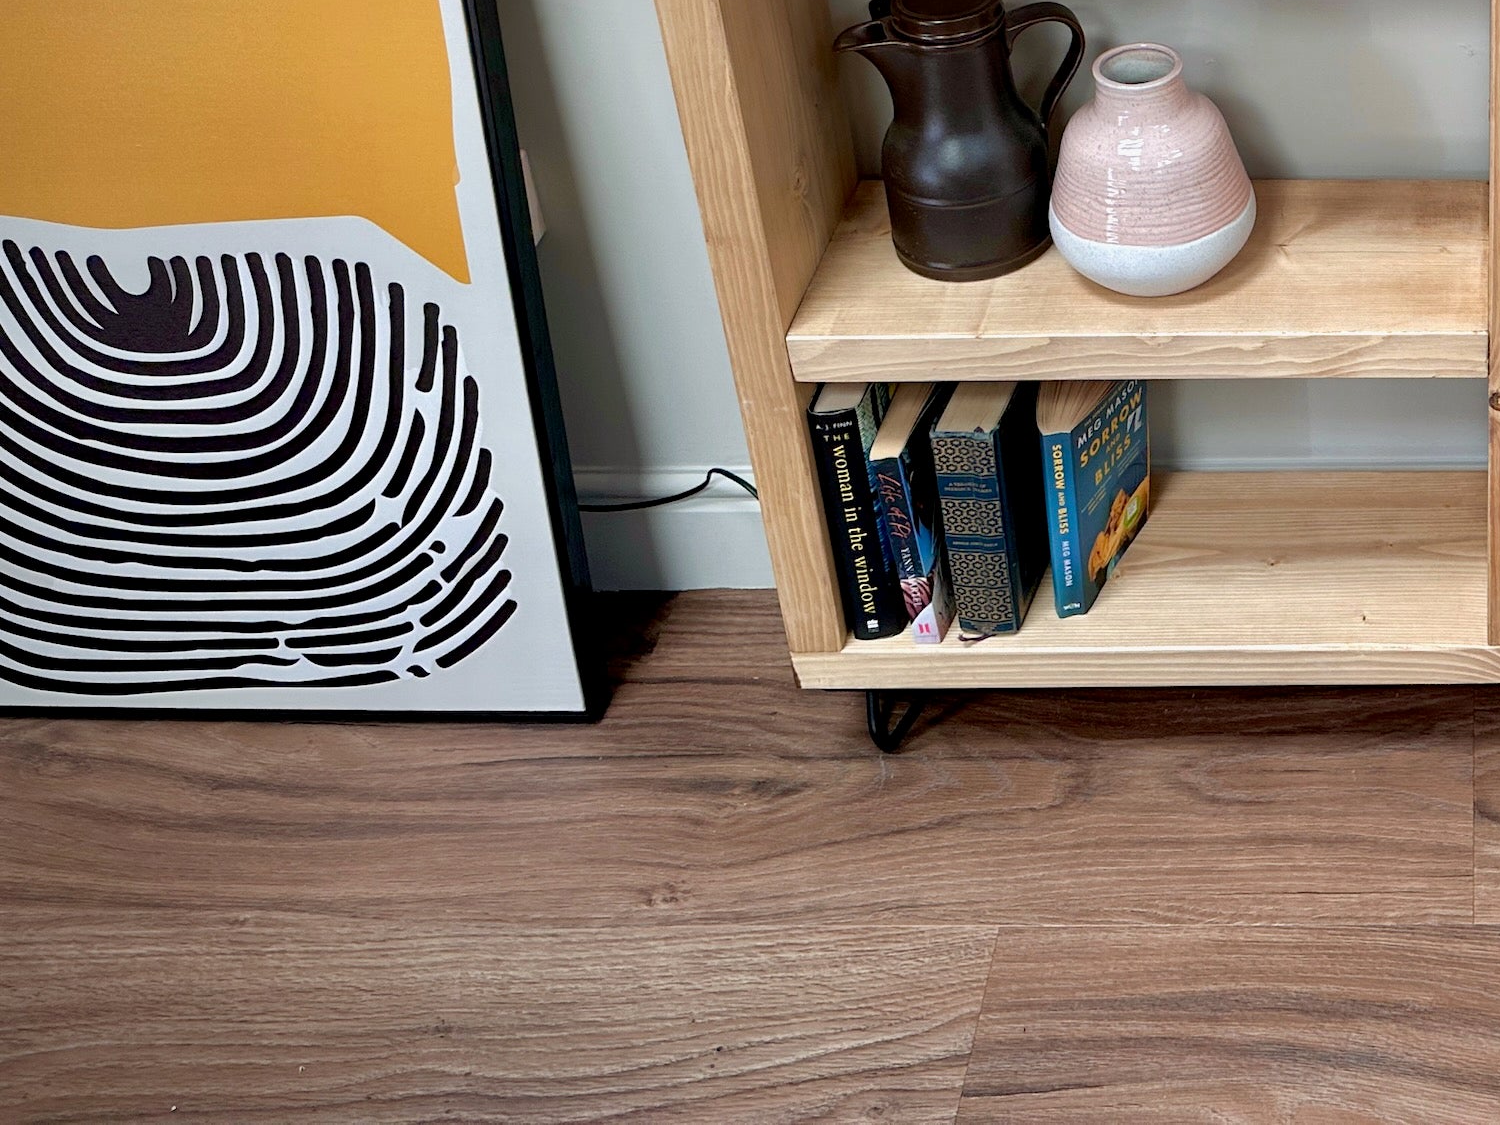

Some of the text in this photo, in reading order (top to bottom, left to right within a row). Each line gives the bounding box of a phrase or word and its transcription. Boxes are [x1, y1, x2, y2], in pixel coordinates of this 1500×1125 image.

[823, 433, 850, 442] THE
[1077, 417, 1102, 449] MEG
[1080, 386, 1143, 468] SORROW
[832, 444, 854, 505] woman
[1052, 444, 1066, 490] SORROW
[1094, 433, 1131, 486] BLISS
[844, 506, 861, 523] in
[1058, 508, 1069, 535] BLISS
[847, 526, 867, 551] the
[853, 554, 878, 614] window
